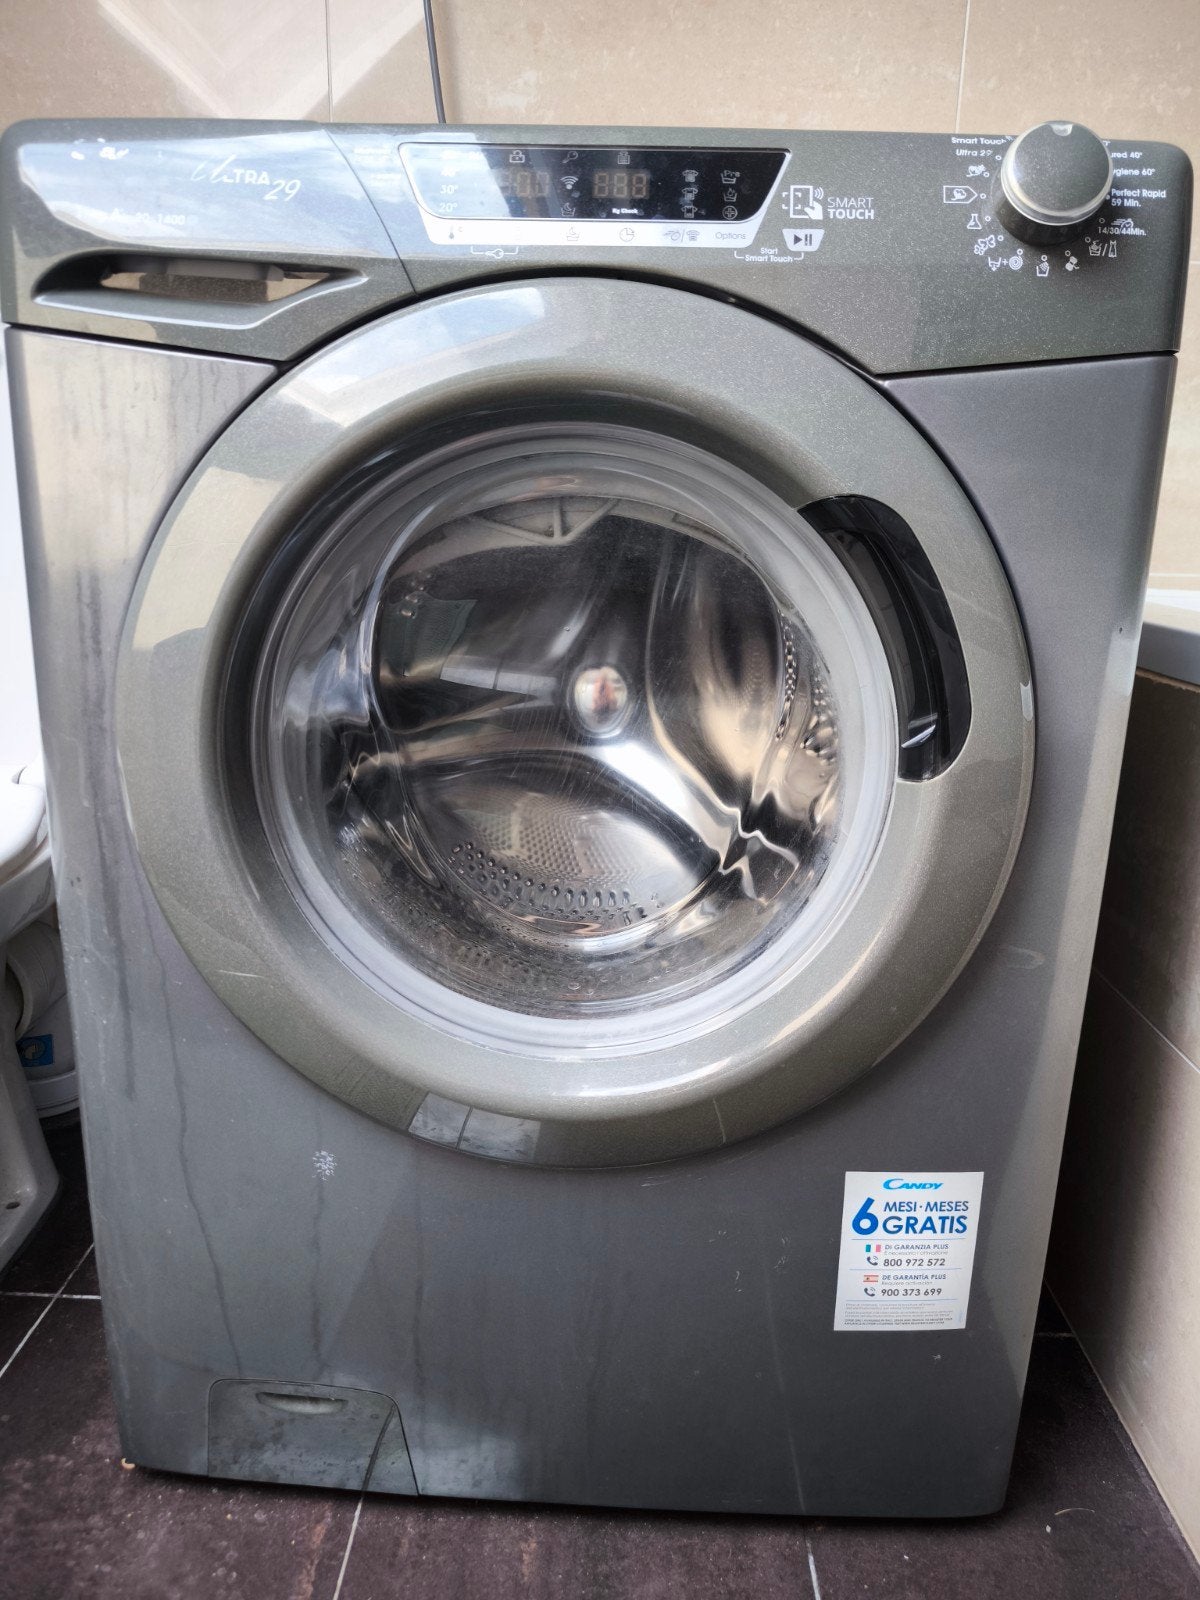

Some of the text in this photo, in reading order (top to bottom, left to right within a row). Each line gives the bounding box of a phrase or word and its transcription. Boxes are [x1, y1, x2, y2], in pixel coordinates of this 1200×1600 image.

[956, 148, 977, 156] Ultra
[263, 179, 302, 201] 29
[1111, 189, 1166, 198] Perfect Rapid
[828, 197, 874, 208] SMART
[1124, 199, 1141, 207] Min.
[828, 209, 875, 220] TOUCH
[715, 231, 746, 240] Options
[760, 247, 778, 255] Start
[745, 254, 793, 263] Smart Touch
[883, 1178, 944, 1190] CANDY
[884, 1201, 917, 1212] MESI
[925, 1201, 969, 1212] MESES
[852, 1197, 879, 1235] 6
[882, 1215, 968, 1235] GRATIS
[883, 1258, 946, 1267] 800 972 572
[881, 1288, 942, 1297] 900 373 699
